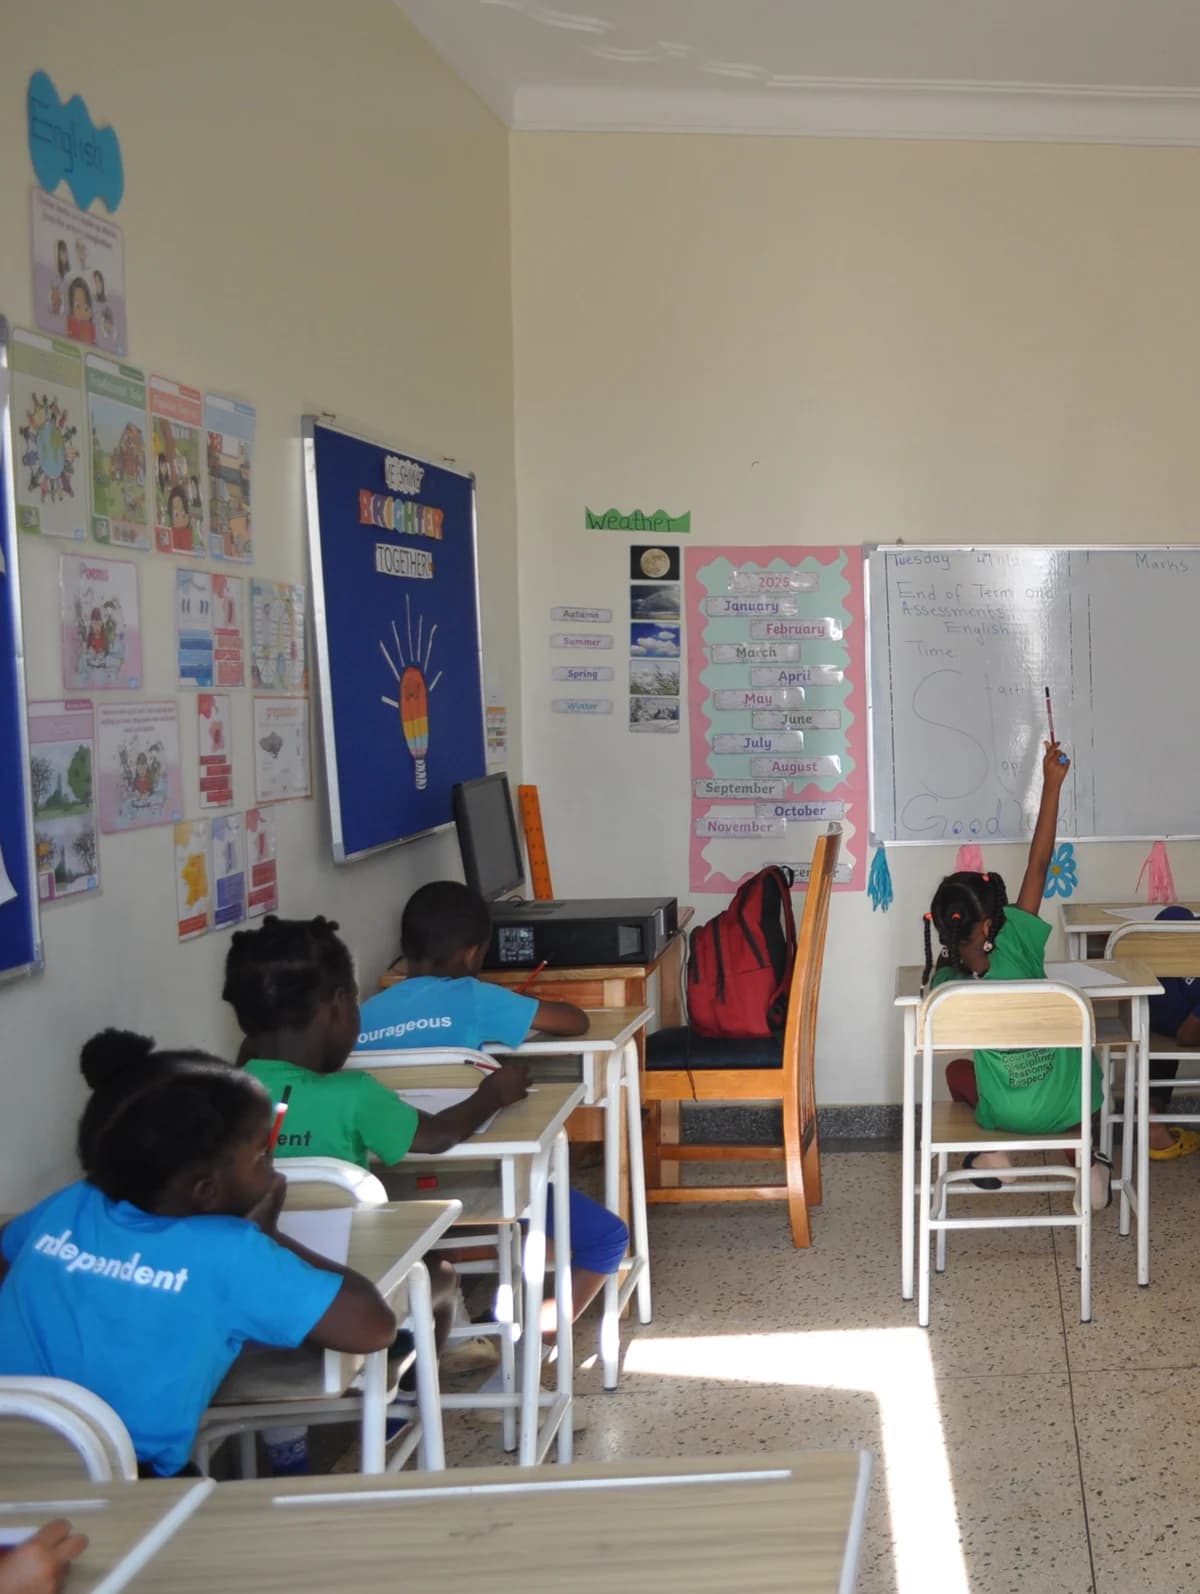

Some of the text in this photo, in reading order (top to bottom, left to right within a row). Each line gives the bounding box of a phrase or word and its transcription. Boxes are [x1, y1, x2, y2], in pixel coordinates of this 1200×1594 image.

[359, 489, 445, 540] BRIGHTER
[888, 552, 951, 571] Tuesday
[759, 577, 790, 588] 2025
[896, 581, 937, 600] End
[945, 583, 963, 602] of
[970, 583, 1011, 599] Term
[723, 600, 780, 614] January
[563, 610, 600, 619] Autumn
[766, 623, 825, 638] February
[944, 622, 1010, 646] English
[564, 637, 601, 647] Summer
[903, 640, 957, 658] Time
[736, 647, 777, 659] March
[568, 670, 598, 681] Spring
[778, 671, 812, 684] April
[744, 693, 773, 707] May
[567, 702, 598, 713] Winter
[780, 714, 813, 726] June
[743, 737, 773, 752] July
[771, 760, 818, 776] August
[705, 783, 776, 796] September
[774, 806, 827, 818] October
[902, 793, 1002, 834] Good
[707, 821, 774, 834] November
[358, 1016, 453, 1044] ourageous
[34, 1229, 188, 1293] ndependent
